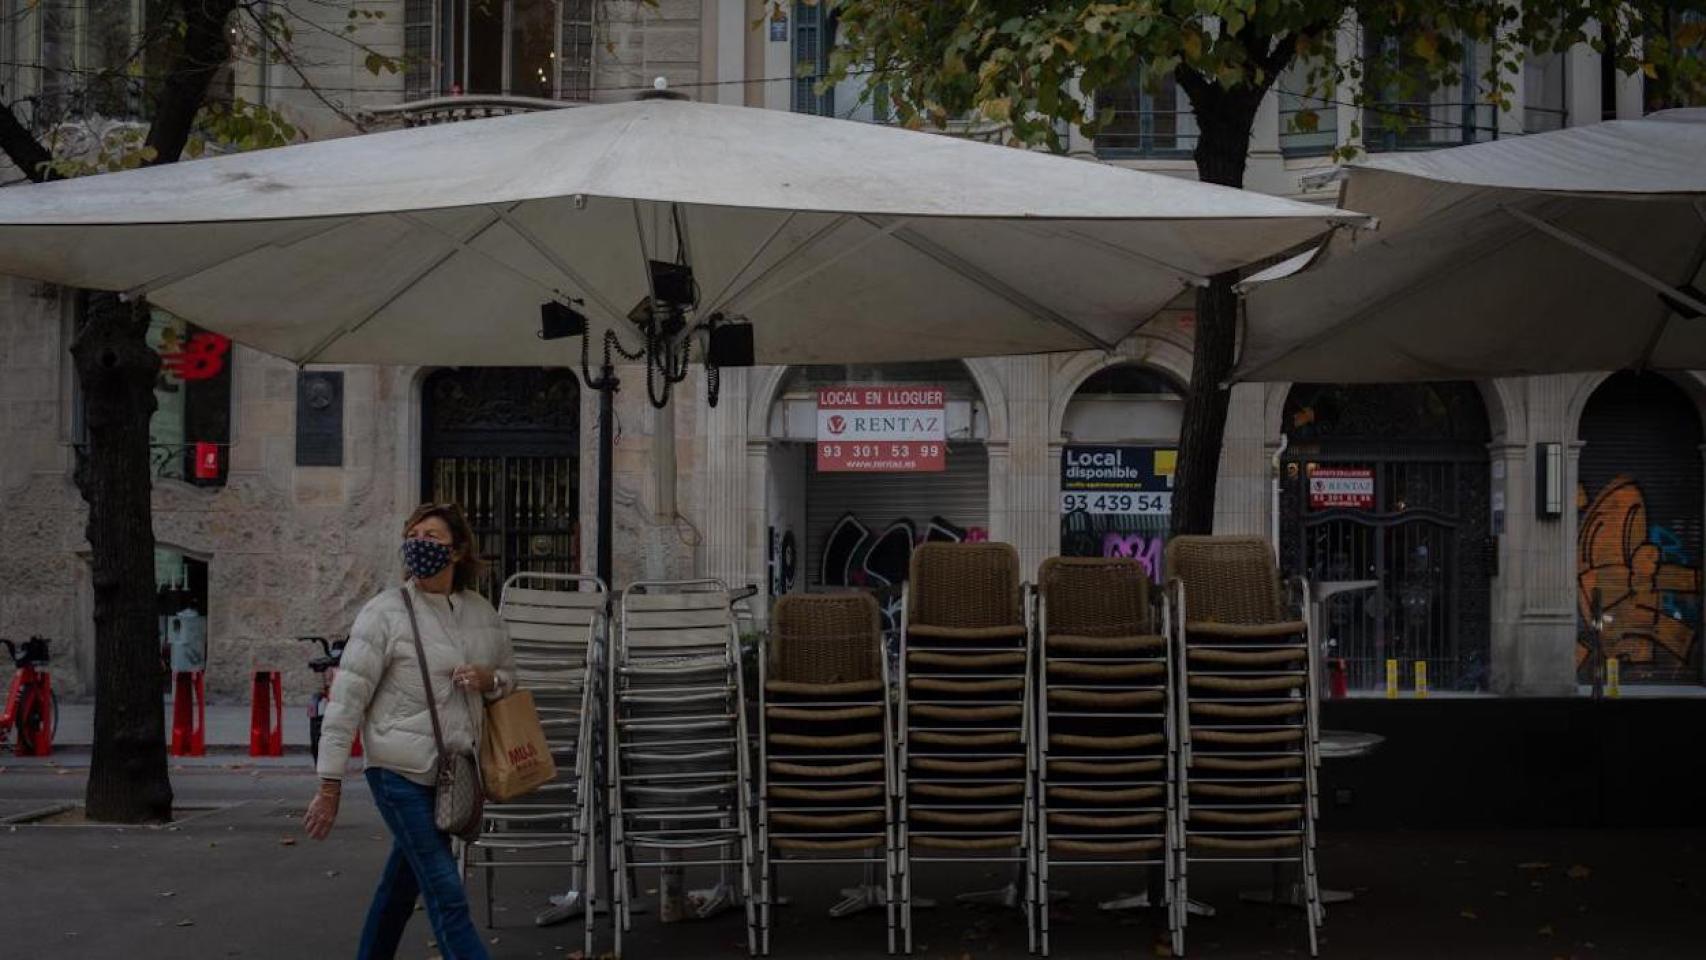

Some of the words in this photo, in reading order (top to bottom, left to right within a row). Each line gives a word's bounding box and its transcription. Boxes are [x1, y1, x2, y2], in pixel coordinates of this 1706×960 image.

[821, 391, 859, 405] LOCAL
[865, 391, 882, 405] EN
[888, 391, 943, 405] LLOGUER
[855, 417, 939, 432] RENTAZ
[823, 445, 841, 457] 93
[853, 445, 879, 457] 301
[891, 445, 909, 457] 53
[920, 445, 939, 457] 99
[1066, 449, 1123, 467] Local
[1066, 466, 1139, 480] disponible
[1064, 495, 1088, 511] 93
[1094, 495, 1132, 511] 439
[1138, 495, 1163, 511] 54
